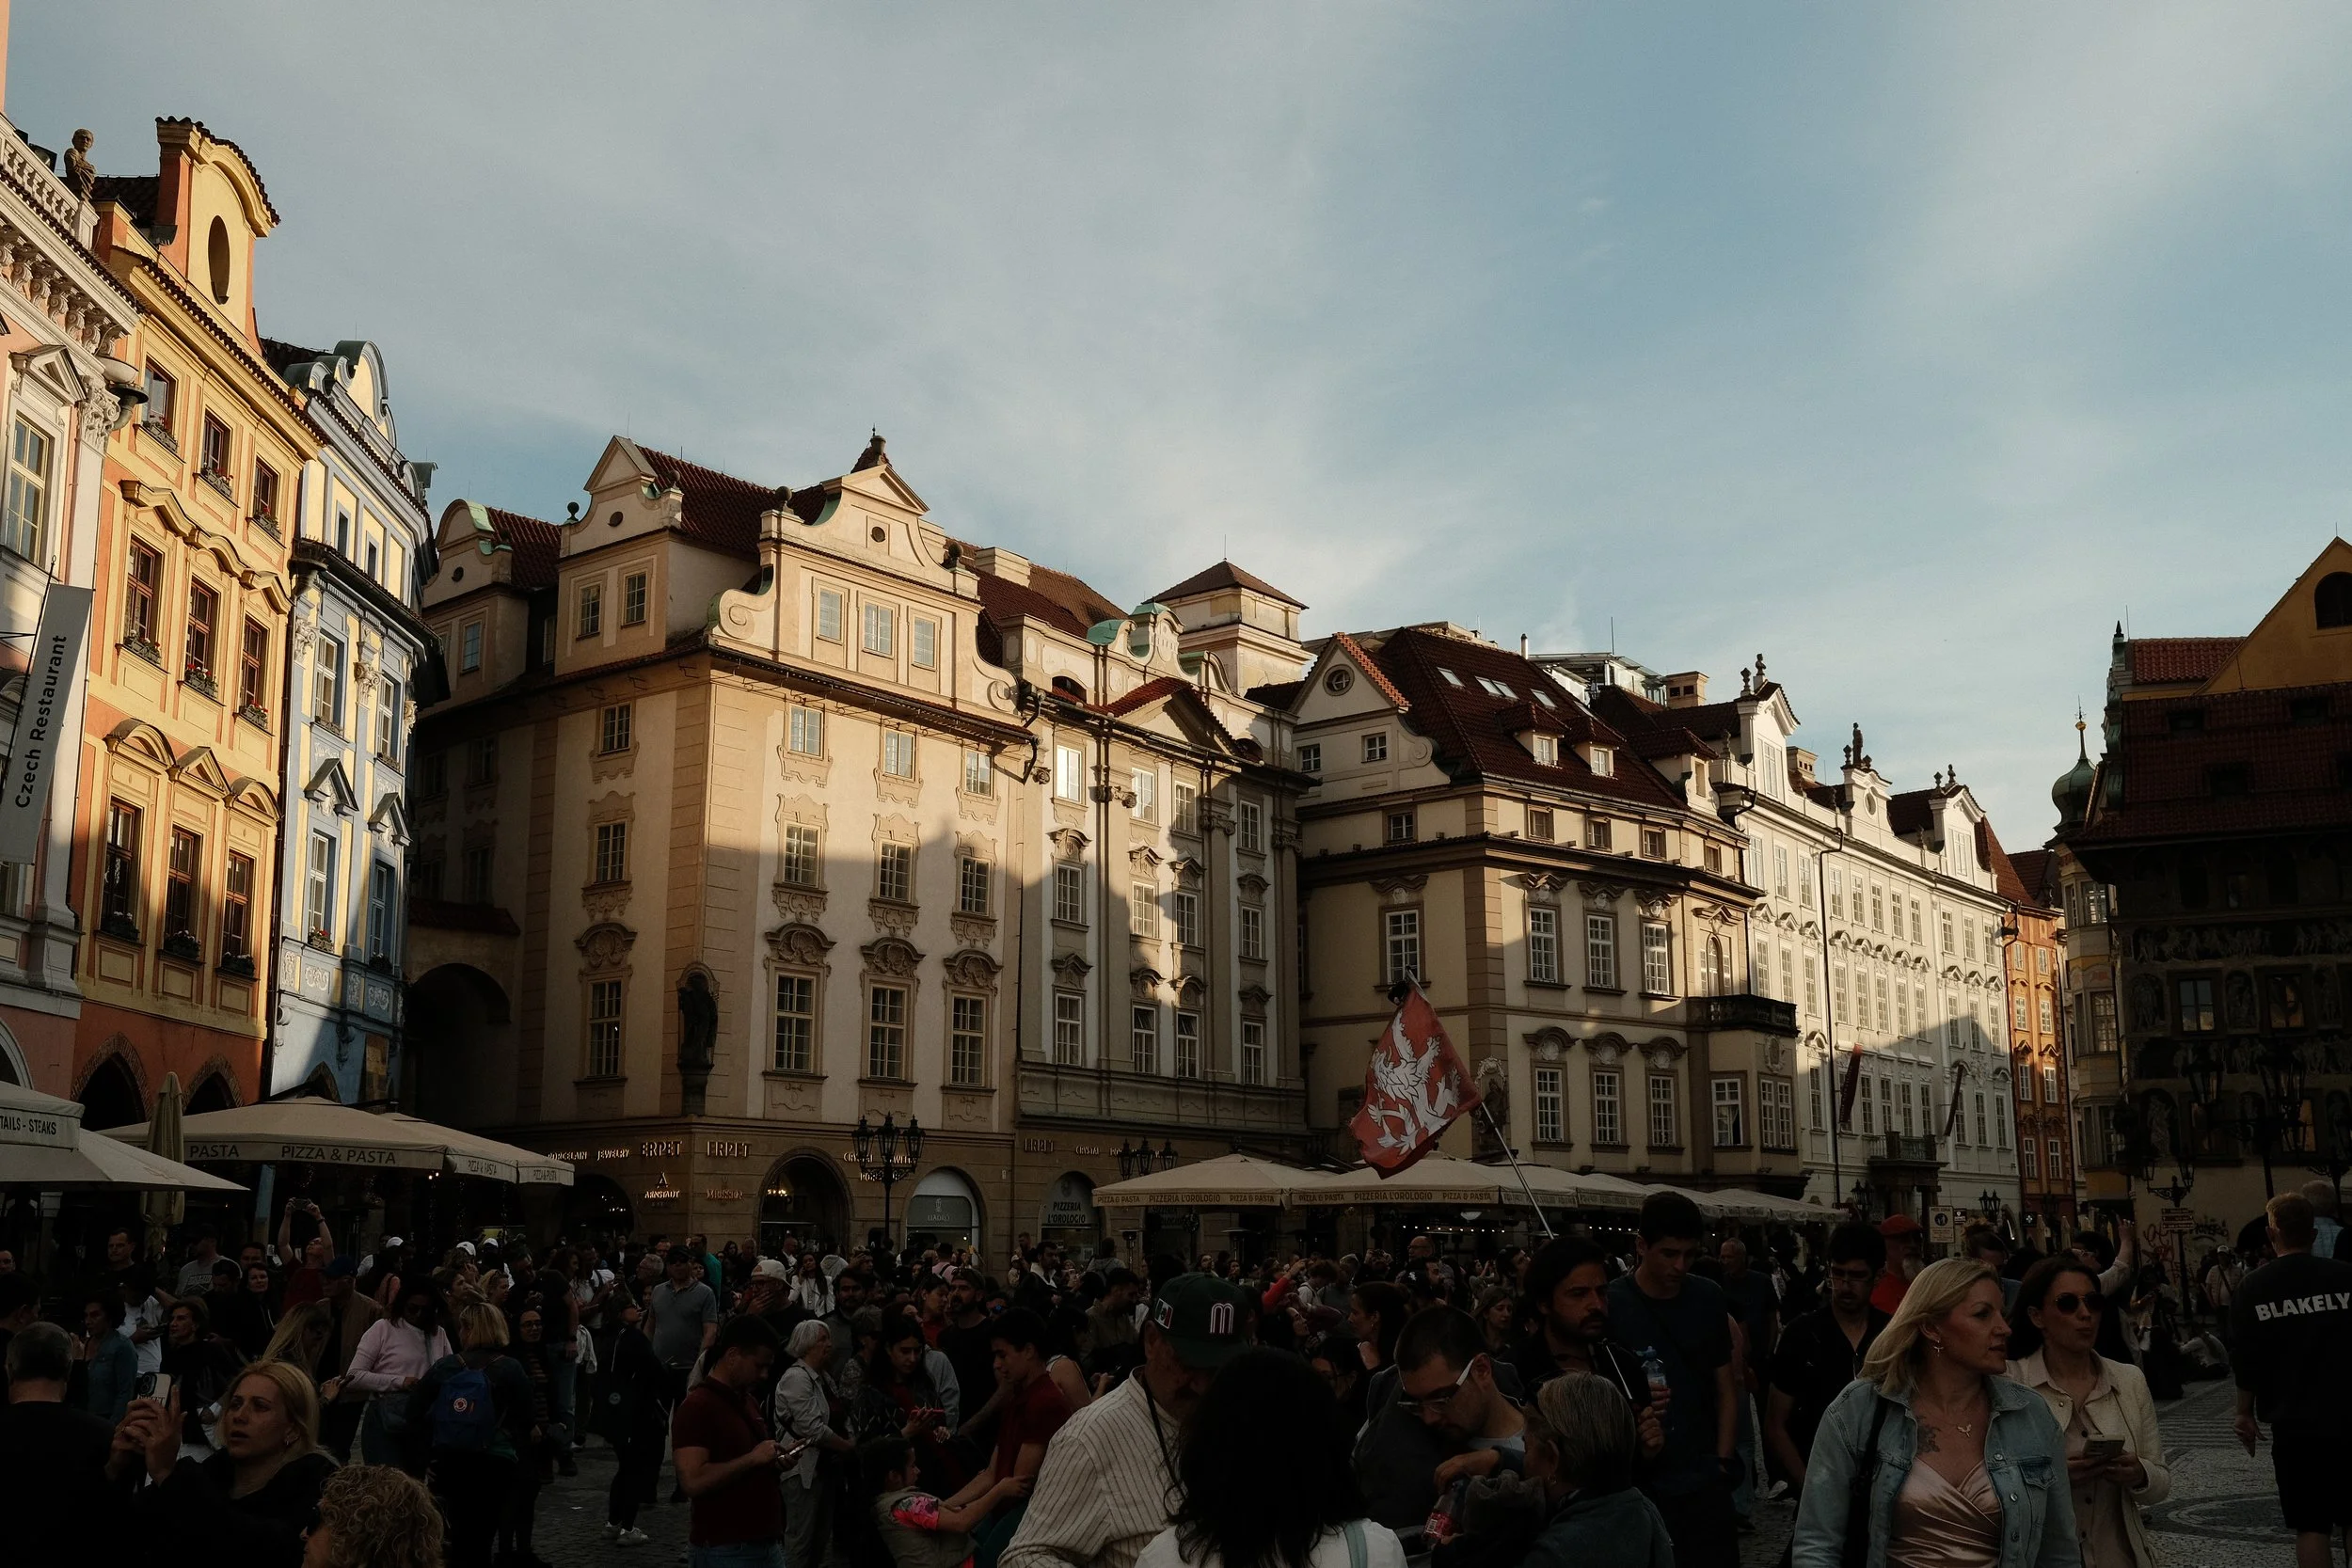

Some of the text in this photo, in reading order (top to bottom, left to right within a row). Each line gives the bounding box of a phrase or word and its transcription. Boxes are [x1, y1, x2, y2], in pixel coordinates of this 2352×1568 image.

[15, 635, 67, 808] Czech Restaurant
[28, 1118, 56, 1135] STEAKS
[190, 1145, 239, 1158] PASTA
[281, 1145, 396, 1164] PIZZA & PASTA
[596, 1148, 629, 1162] JEWELRY
[642, 1140, 682, 1158] ERPET
[1149, 1195, 1180, 1203] PIZZERIA
[1354, 1192, 1388, 1201] PIZZERIA
[1470, 1193, 1491, 1201] PASTA
[1053, 1201, 1081, 1212] PIZZERIA
[2254, 1292, 2351, 1322] BLAKELY
